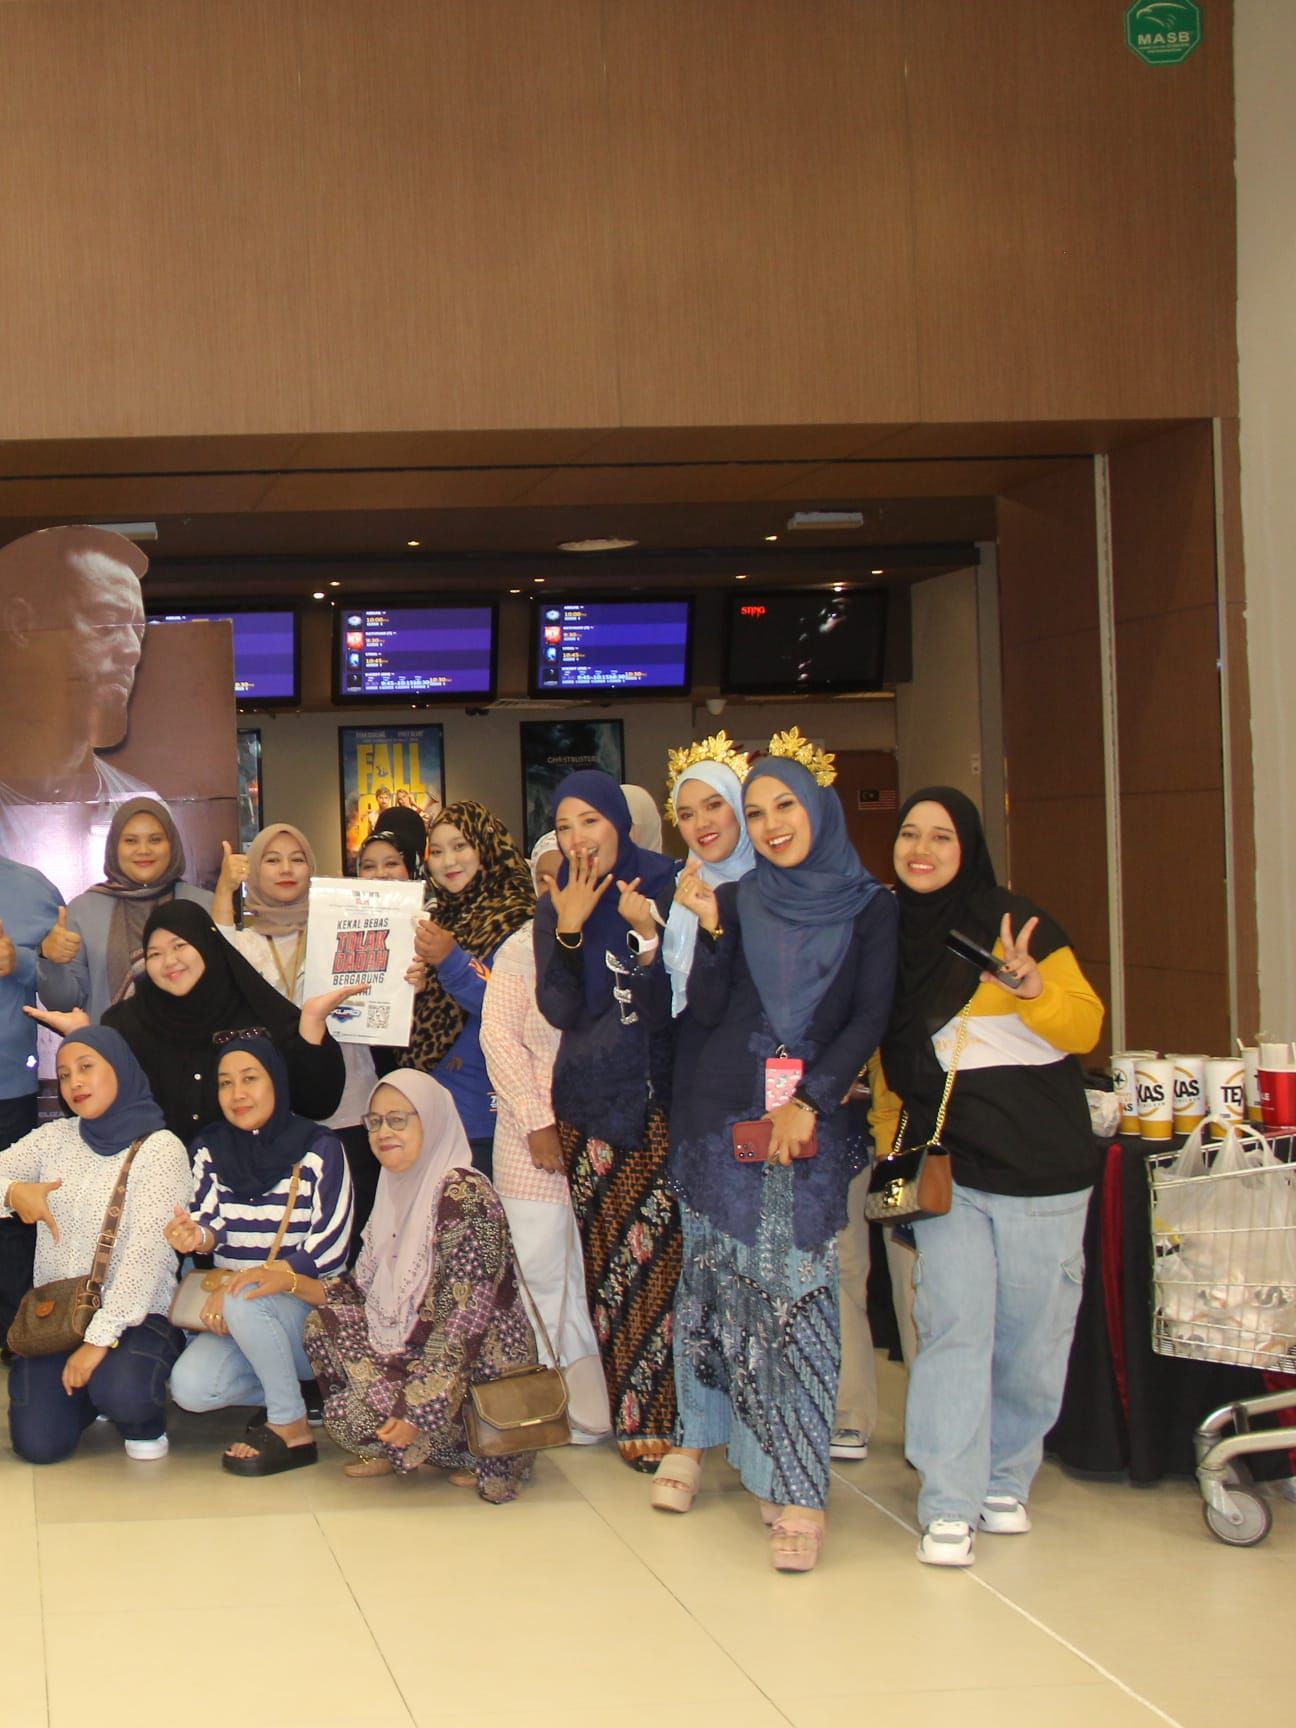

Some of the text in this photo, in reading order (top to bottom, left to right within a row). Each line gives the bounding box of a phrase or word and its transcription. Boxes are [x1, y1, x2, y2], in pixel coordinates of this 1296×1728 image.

[1137, 31, 1191, 45] MASB
[356, 743, 427, 794] FALL
[337, 917, 389, 930] KEKAL BEBAS
[337, 929, 391, 952] TOLAK
[332, 949, 390, 974] DADAH
[332, 973, 385, 986] BERGABUNG
